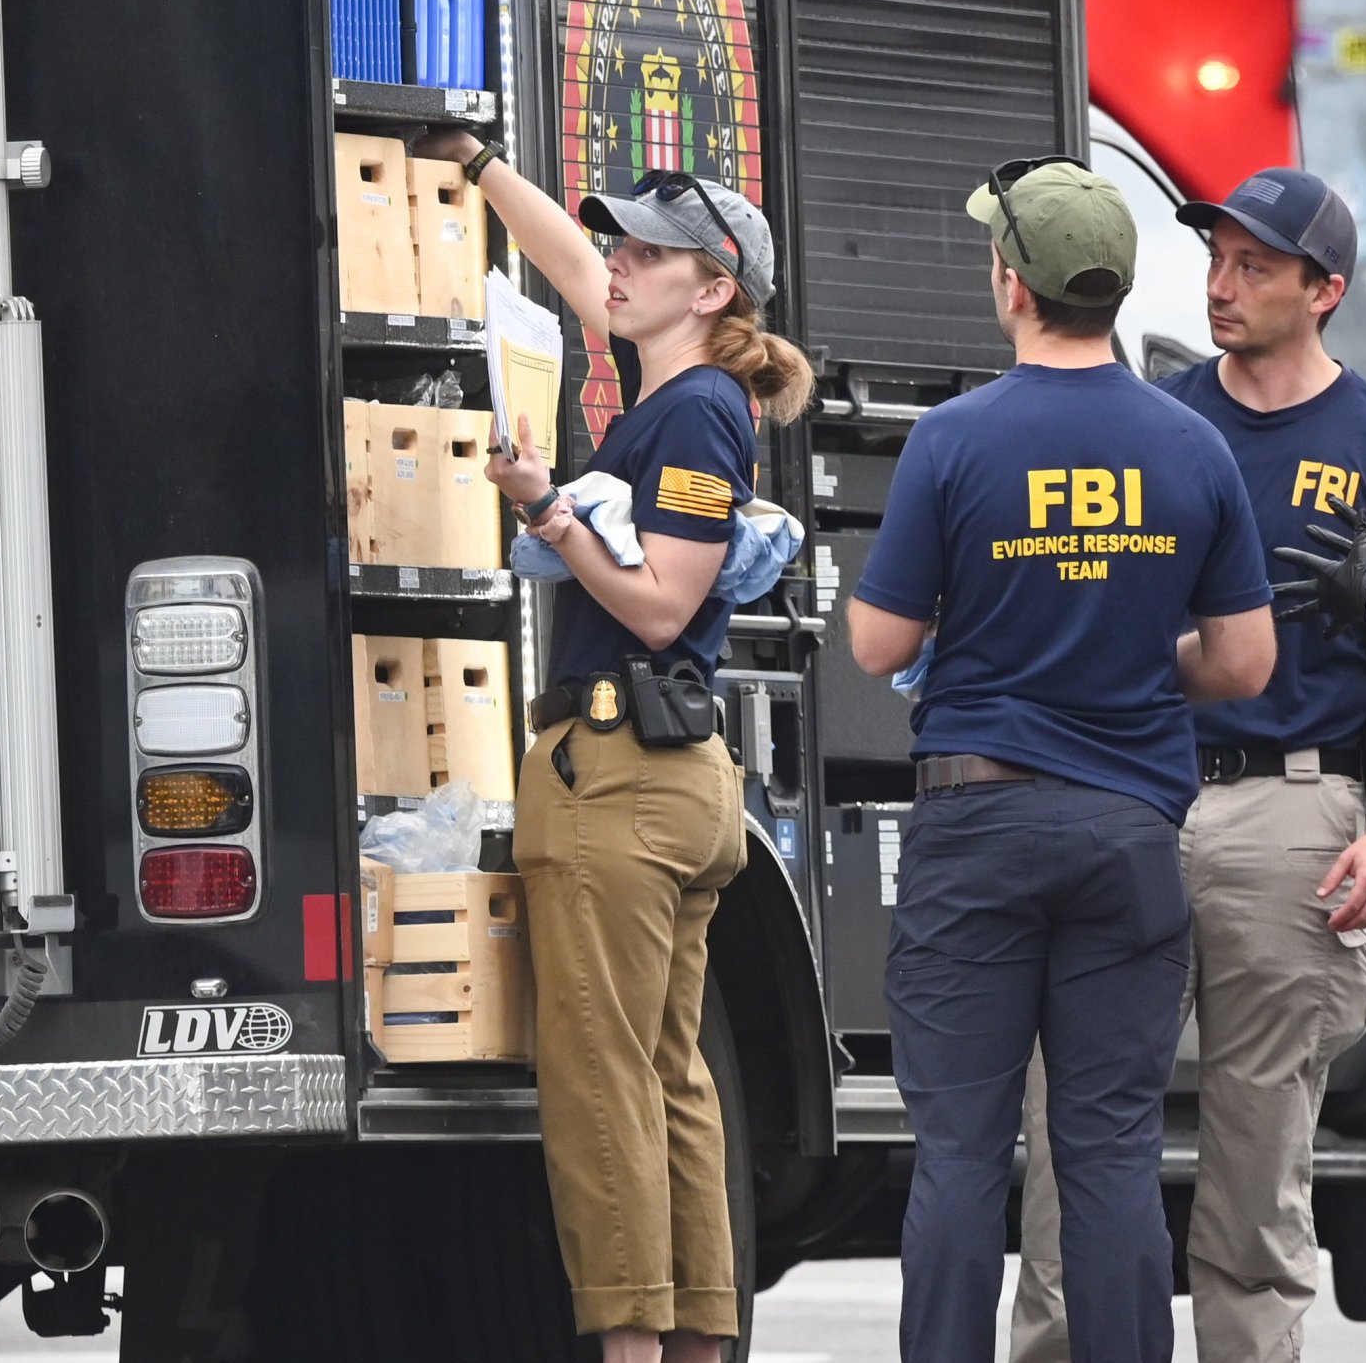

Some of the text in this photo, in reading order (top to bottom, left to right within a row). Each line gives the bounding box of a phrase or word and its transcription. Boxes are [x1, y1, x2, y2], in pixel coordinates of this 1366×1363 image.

[1027, 467, 1143, 529] FBI
[1291, 459, 1360, 514] FBI
[991, 533, 1176, 560] EVIDENCE RESPONSE
[1056, 560, 1109, 582] TEAM
[144, 1007, 248, 1053] LDV
